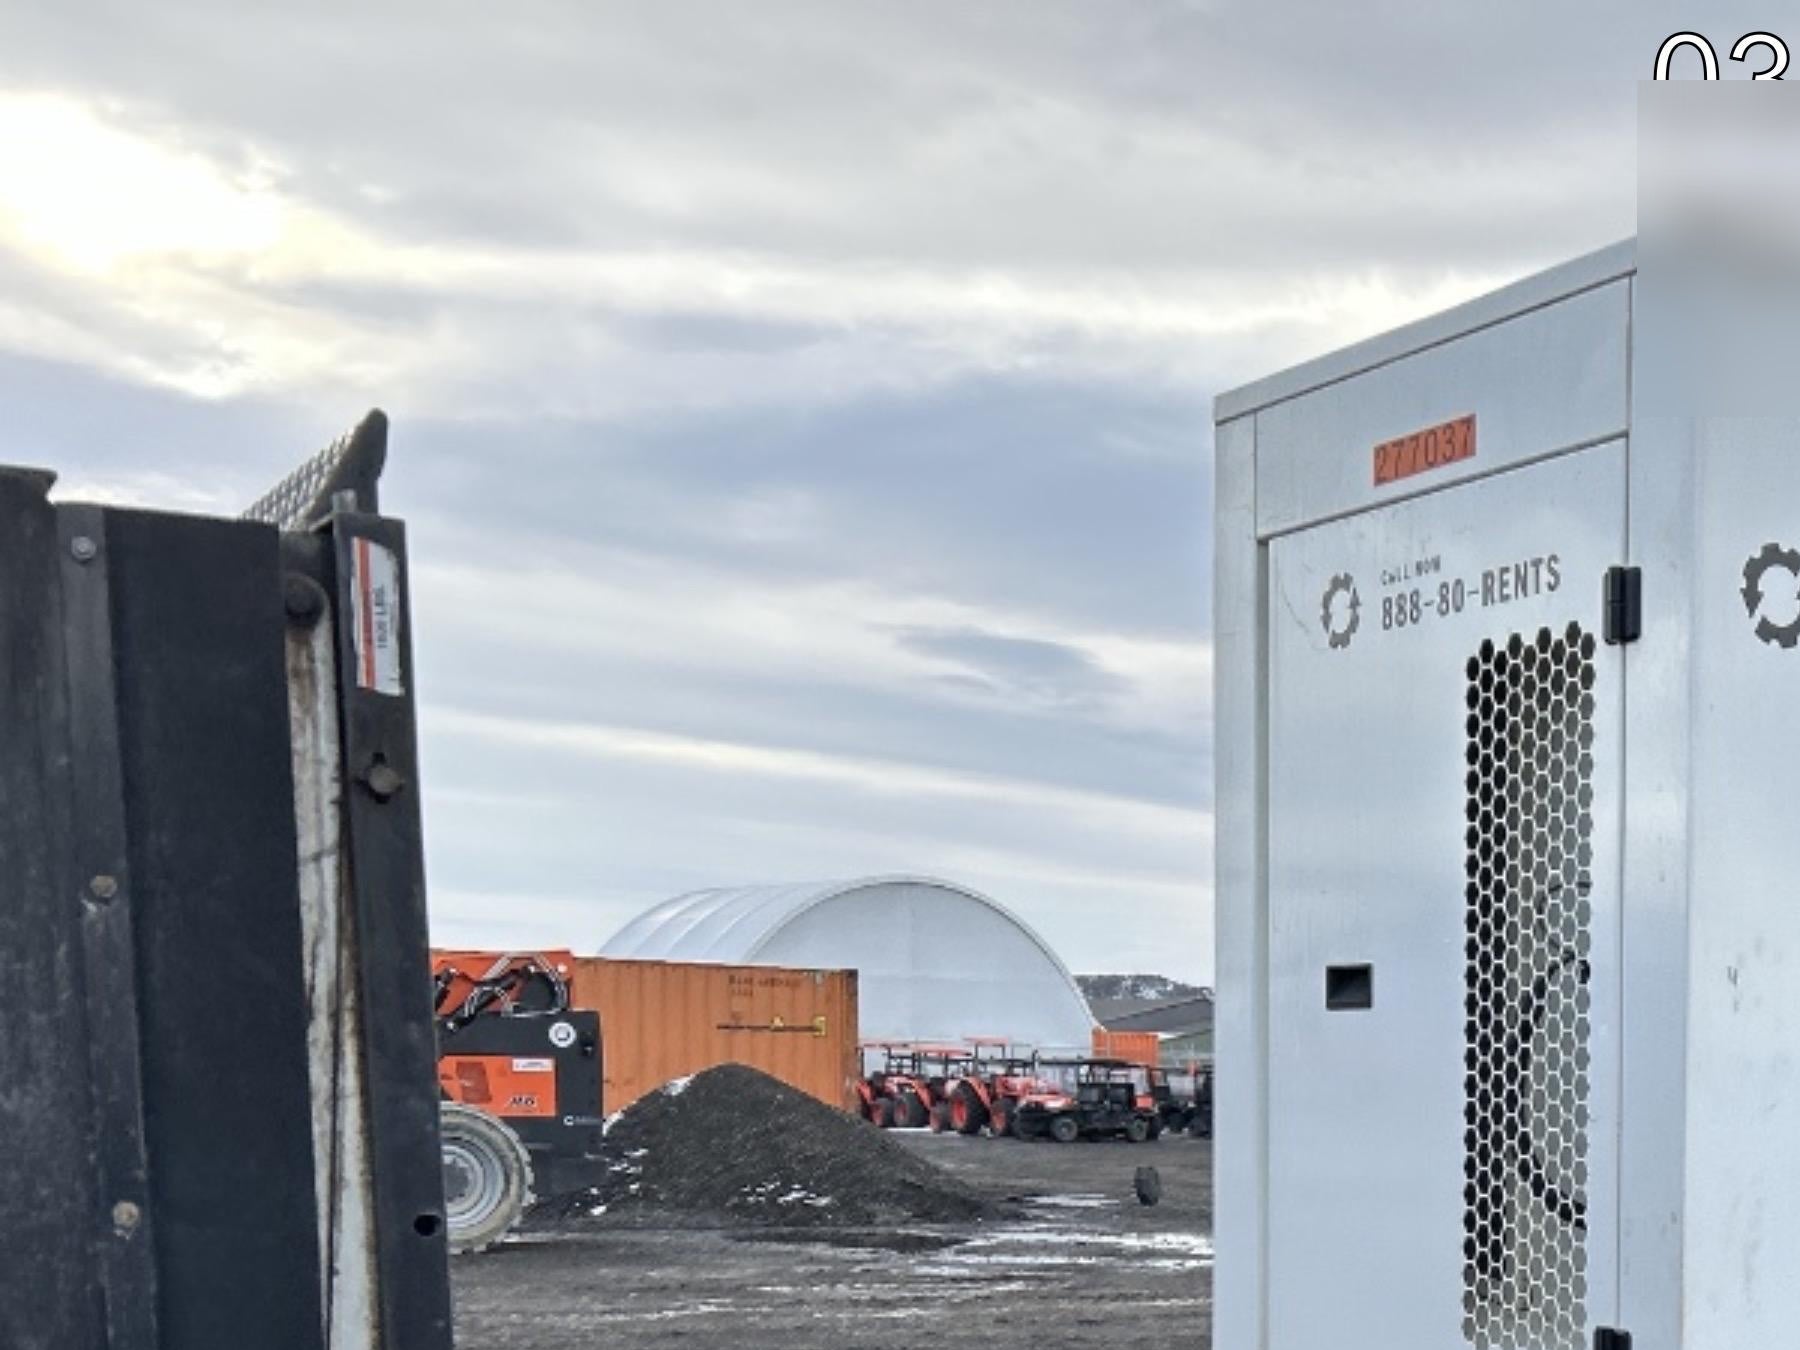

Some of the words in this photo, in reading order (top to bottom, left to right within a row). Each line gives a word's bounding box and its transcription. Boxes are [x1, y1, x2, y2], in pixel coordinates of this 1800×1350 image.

[1375, 415, 1474, 482] 277037
[1381, 553, 1561, 631] 888-80-RENTS
[1414, 555, 1441, 576] NOW
